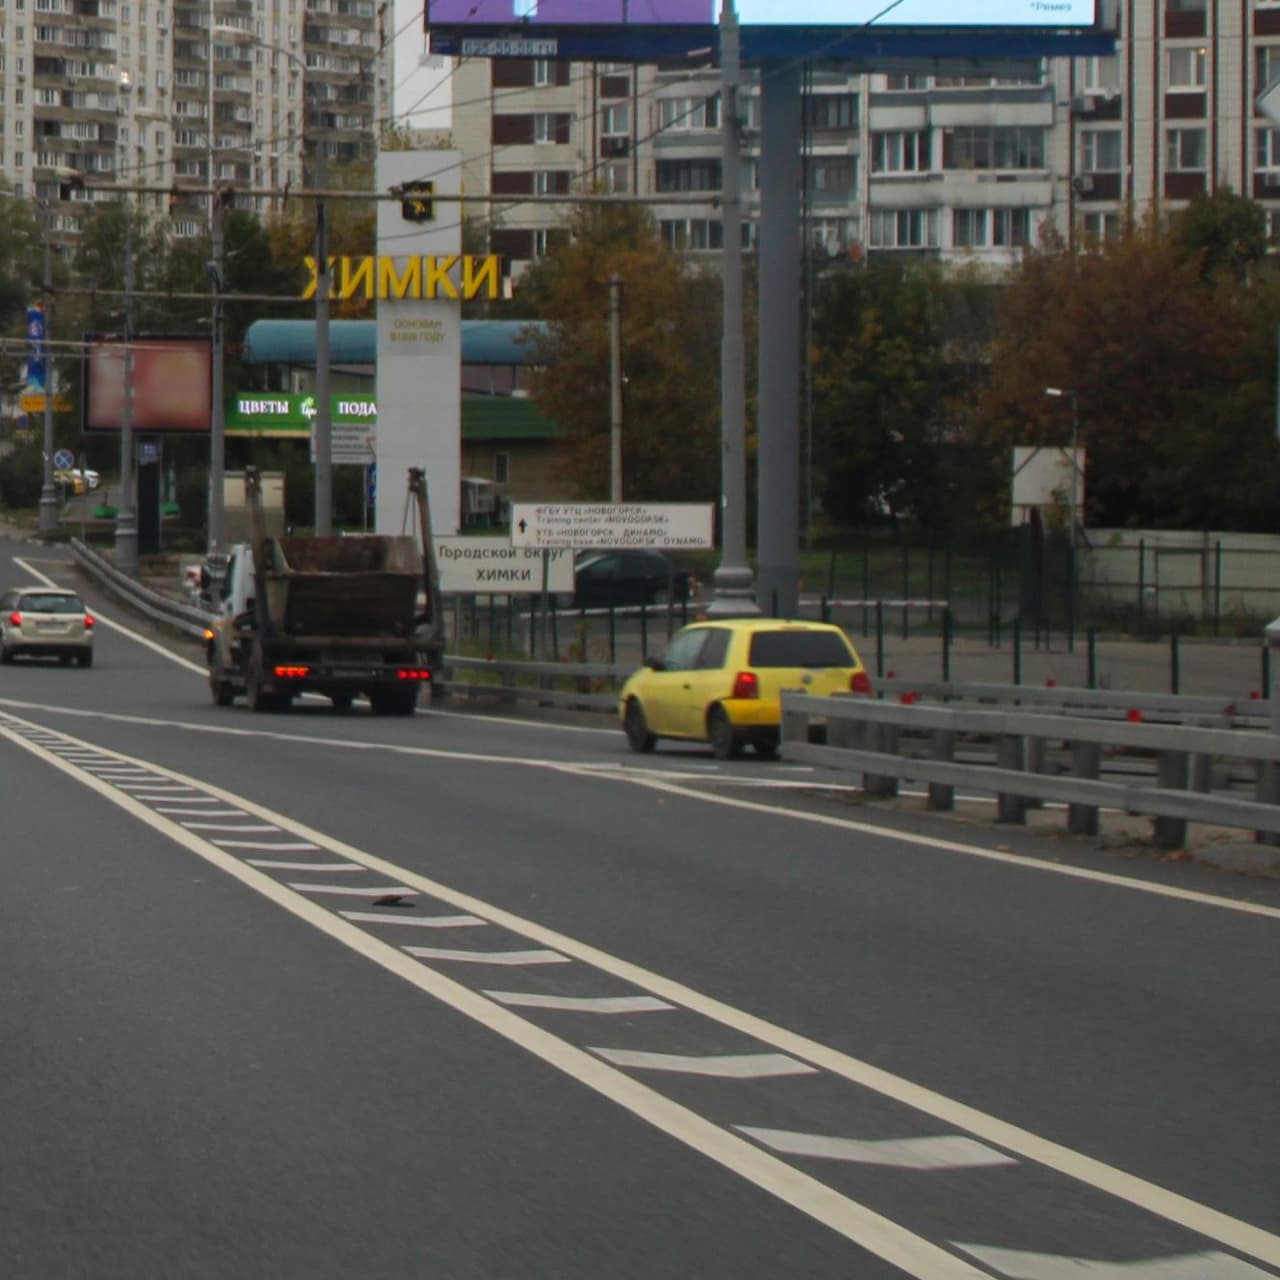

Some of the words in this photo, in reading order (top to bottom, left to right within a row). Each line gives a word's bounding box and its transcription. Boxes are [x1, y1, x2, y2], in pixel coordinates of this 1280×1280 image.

[302, 254, 500, 300] ХИМКИ
[239, 400, 289, 415] ЦВЕТЫ
[439, 544, 517, 561] Городской
[476, 569, 532, 582] ХИМКИ
